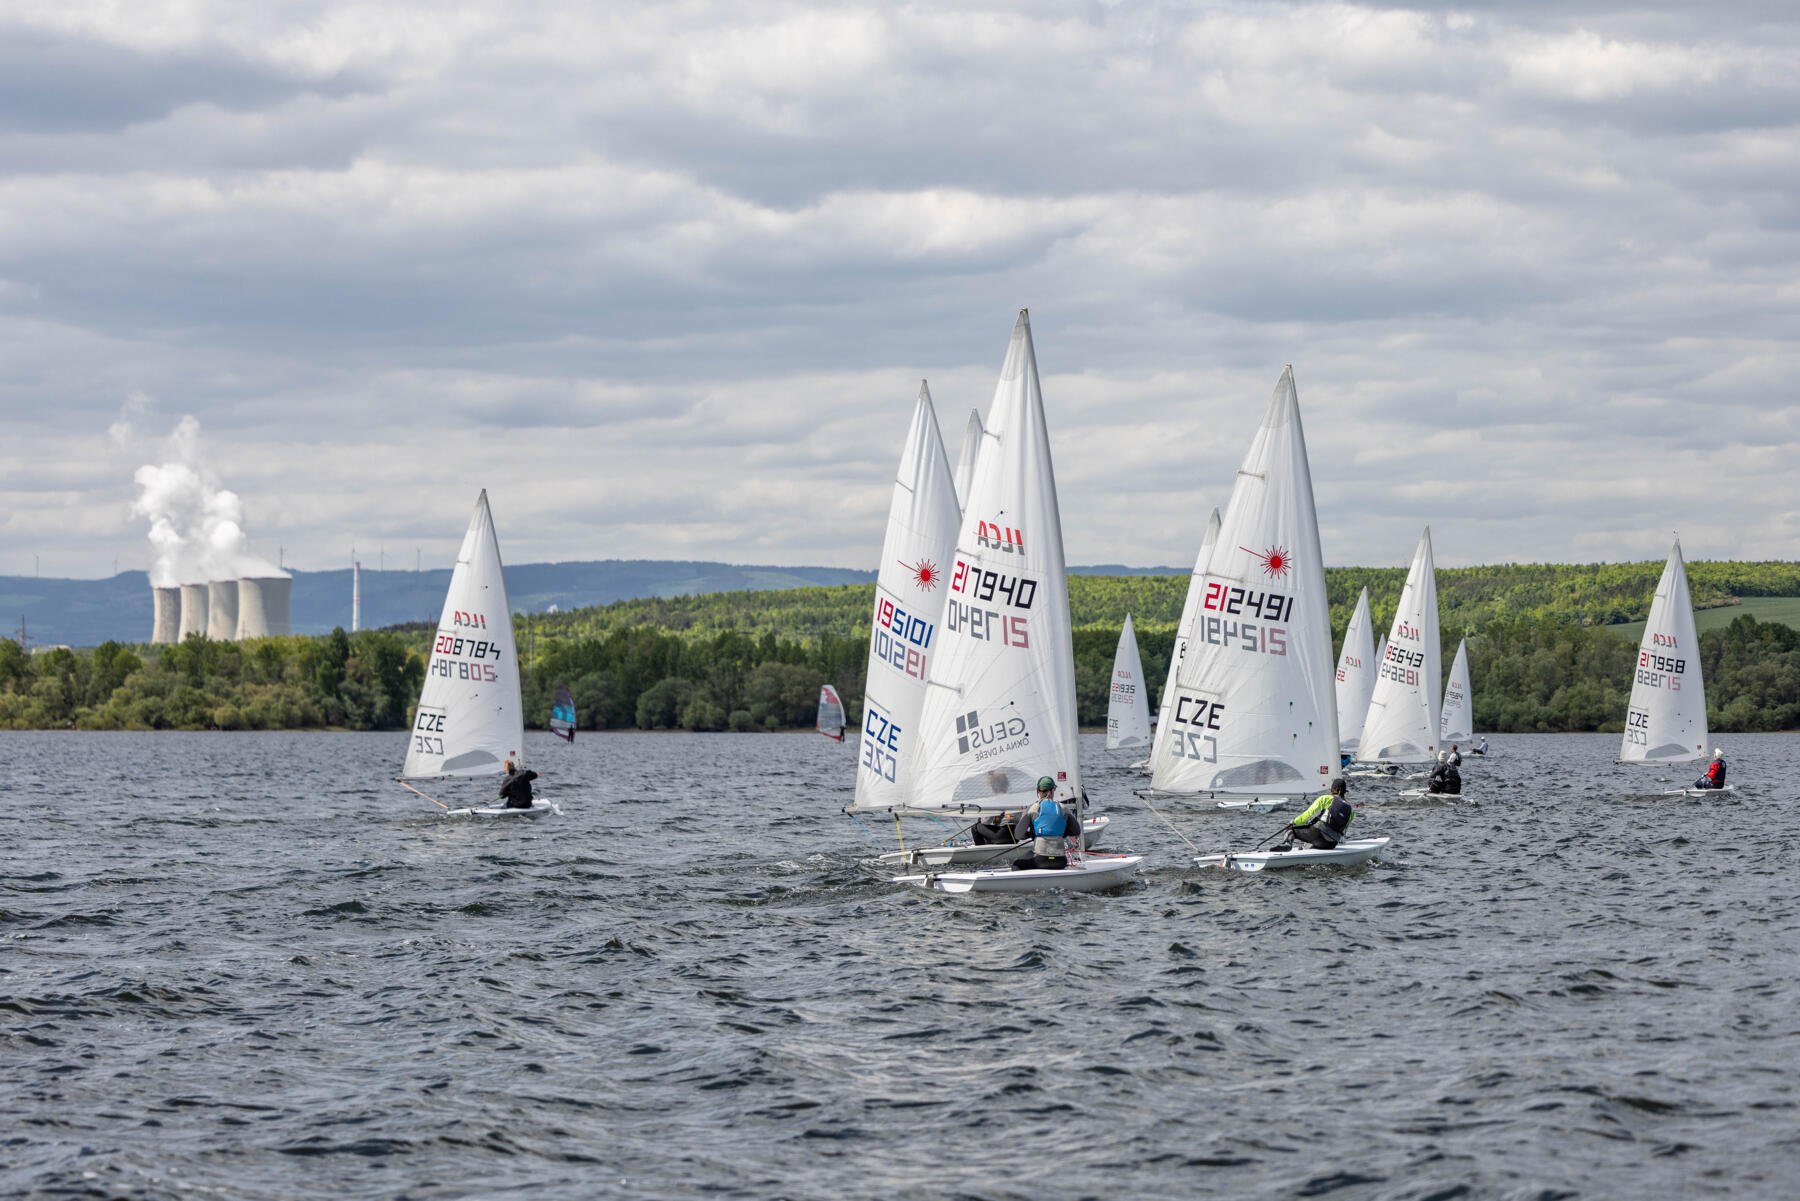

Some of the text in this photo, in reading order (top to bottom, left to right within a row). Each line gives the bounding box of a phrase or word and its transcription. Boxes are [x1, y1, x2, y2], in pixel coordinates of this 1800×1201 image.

[952, 561, 1037, 609] 217940
[1204, 583, 1293, 622] 212491
[877, 597, 933, 648] 195101
[436, 636, 501, 660] 208784
[1640, 652, 1685, 673] 217958
[417, 713, 446, 732] CZE
[1175, 696, 1225, 730] CZE
[1629, 711, 1649, 728] CZE
[866, 709, 901, 752] CZE
